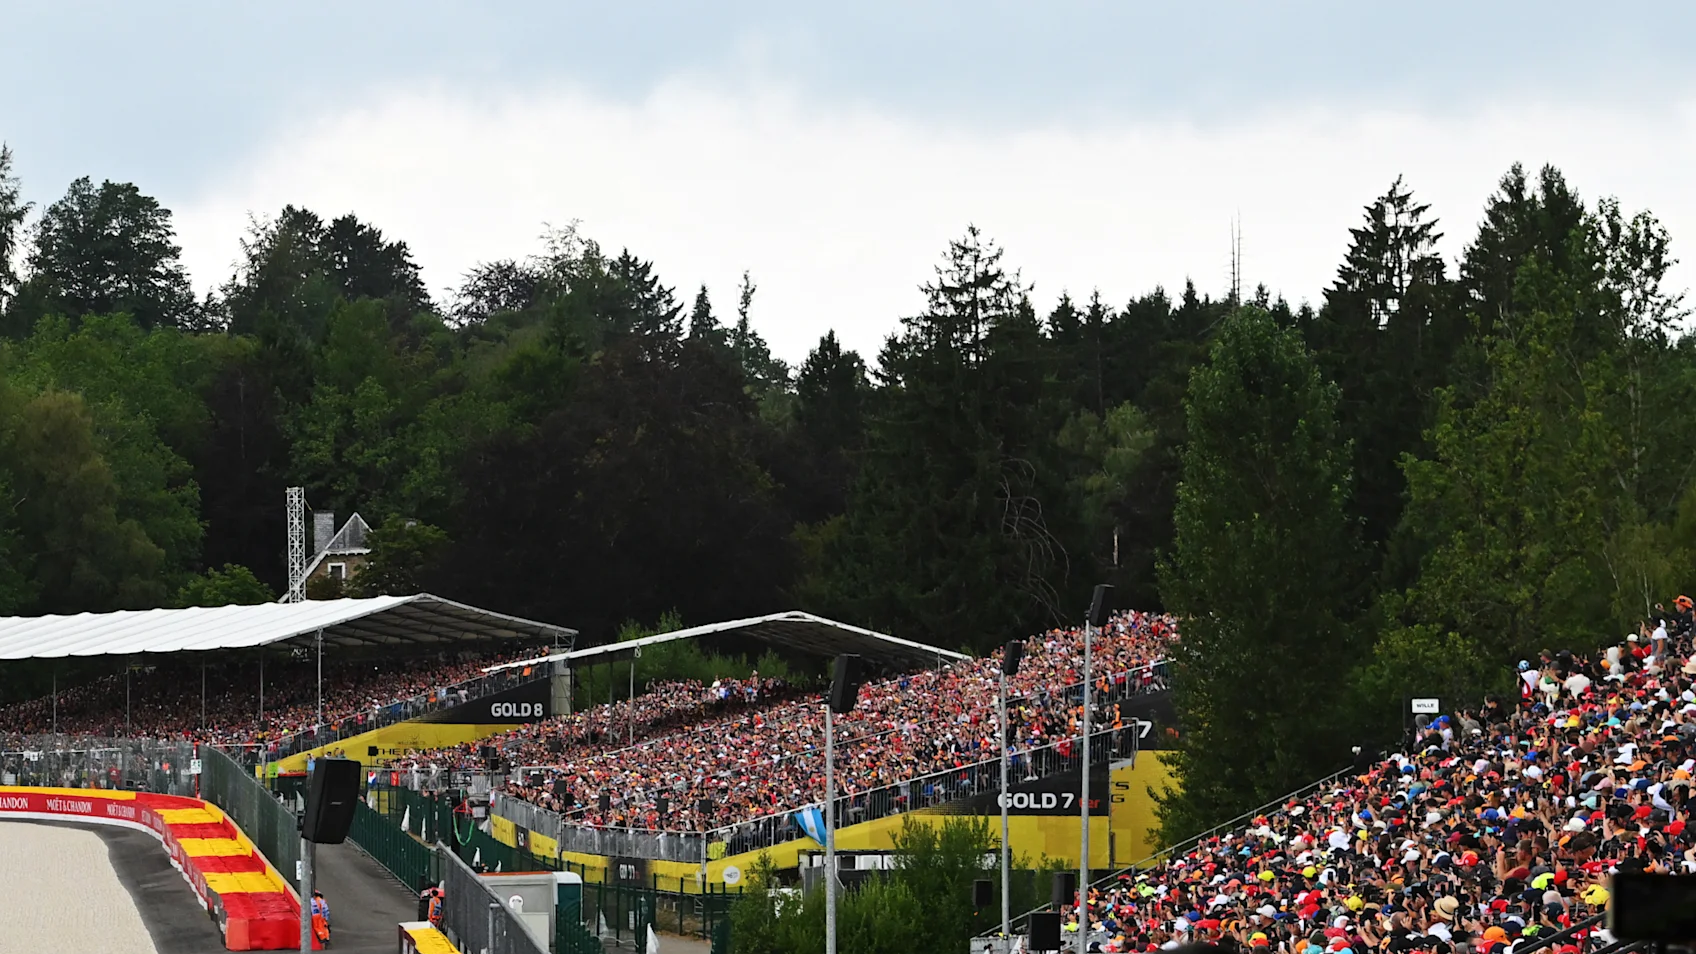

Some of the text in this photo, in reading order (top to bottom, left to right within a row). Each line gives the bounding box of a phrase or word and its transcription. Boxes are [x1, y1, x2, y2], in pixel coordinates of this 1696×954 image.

[491, 702, 543, 717] GOLD 8
[997, 792, 1057, 809] GOLD
[1061, 792, 1075, 809] 7
